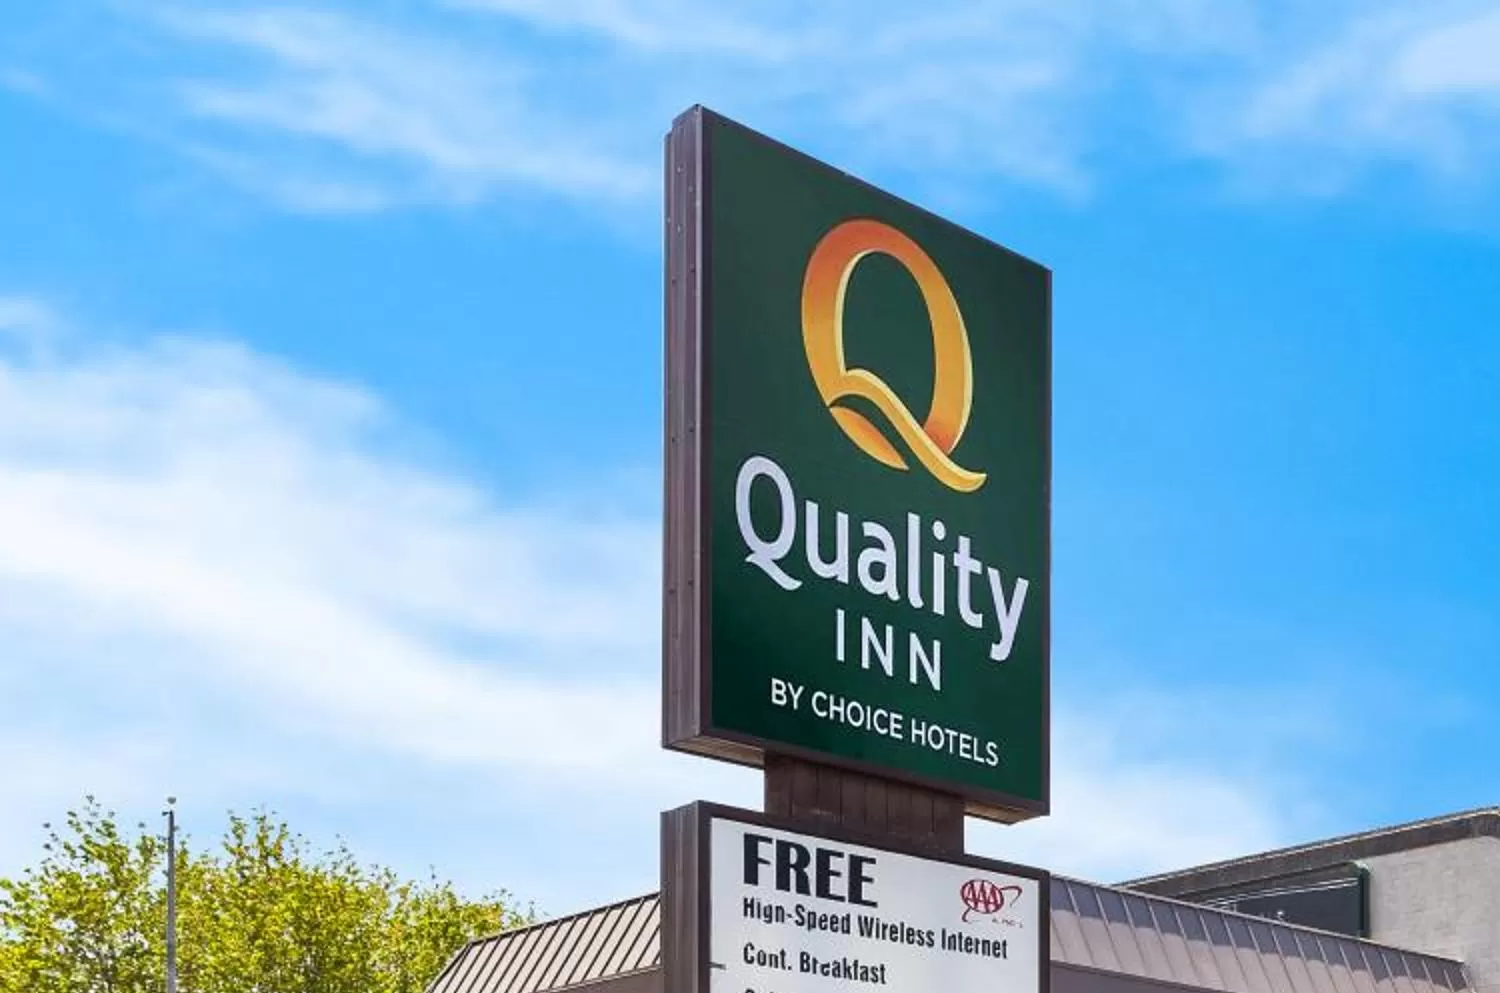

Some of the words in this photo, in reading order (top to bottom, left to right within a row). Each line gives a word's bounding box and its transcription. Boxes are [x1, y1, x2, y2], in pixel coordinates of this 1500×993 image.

[801, 218, 987, 493] Q
[735, 455, 1030, 661] Quality
[836, 608, 943, 691] INN
[771, 678, 804, 710] BY
[811, 691, 903, 739] CHOICE
[911, 718, 999, 767] HOTELS
[743, 832, 878, 908] FREE
[963, 879, 1004, 914] AAA
[743, 942, 792, 971] Cont.
[799, 951, 886, 984] Breakfast
[857, 914, 935, 948] Wireless
[941, 928, 1008, 959] Internet
